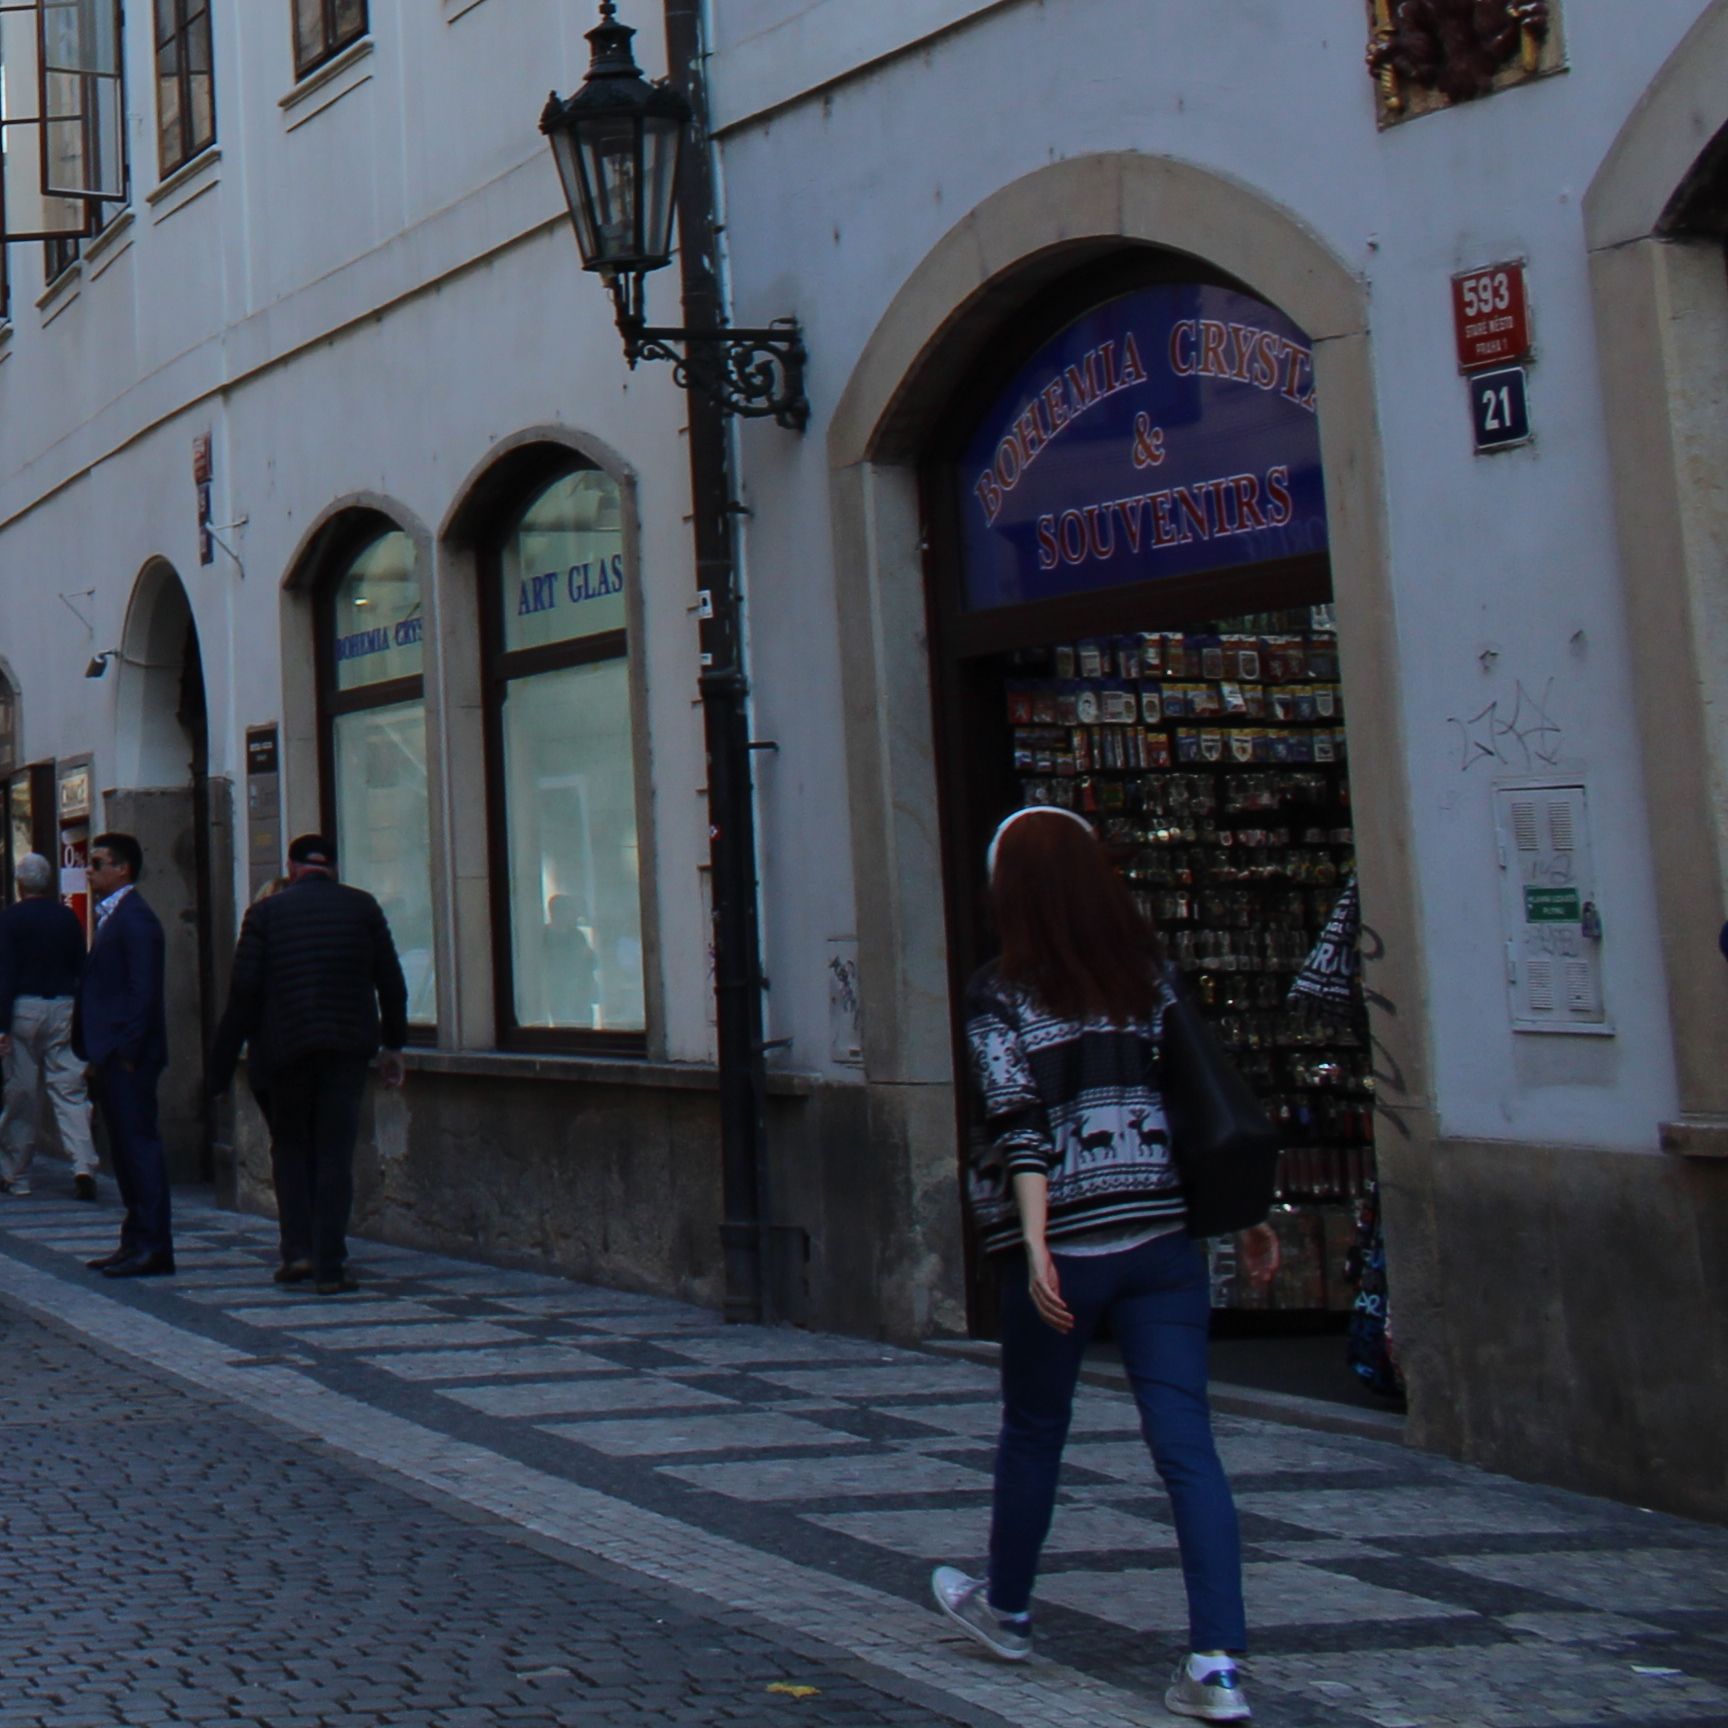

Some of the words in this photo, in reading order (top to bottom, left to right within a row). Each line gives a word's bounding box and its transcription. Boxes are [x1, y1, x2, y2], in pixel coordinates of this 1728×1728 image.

[1463, 272, 1511, 317] 593
[974, 331, 1147, 528] BOHEMIA
[1482, 385, 1513, 432] 21
[1132, 410, 1166, 470] &
[1037, 465, 1293, 570] SOUVENIRS
[518, 571, 558, 616] ART
[335, 626, 391, 662] BOHEMIA
